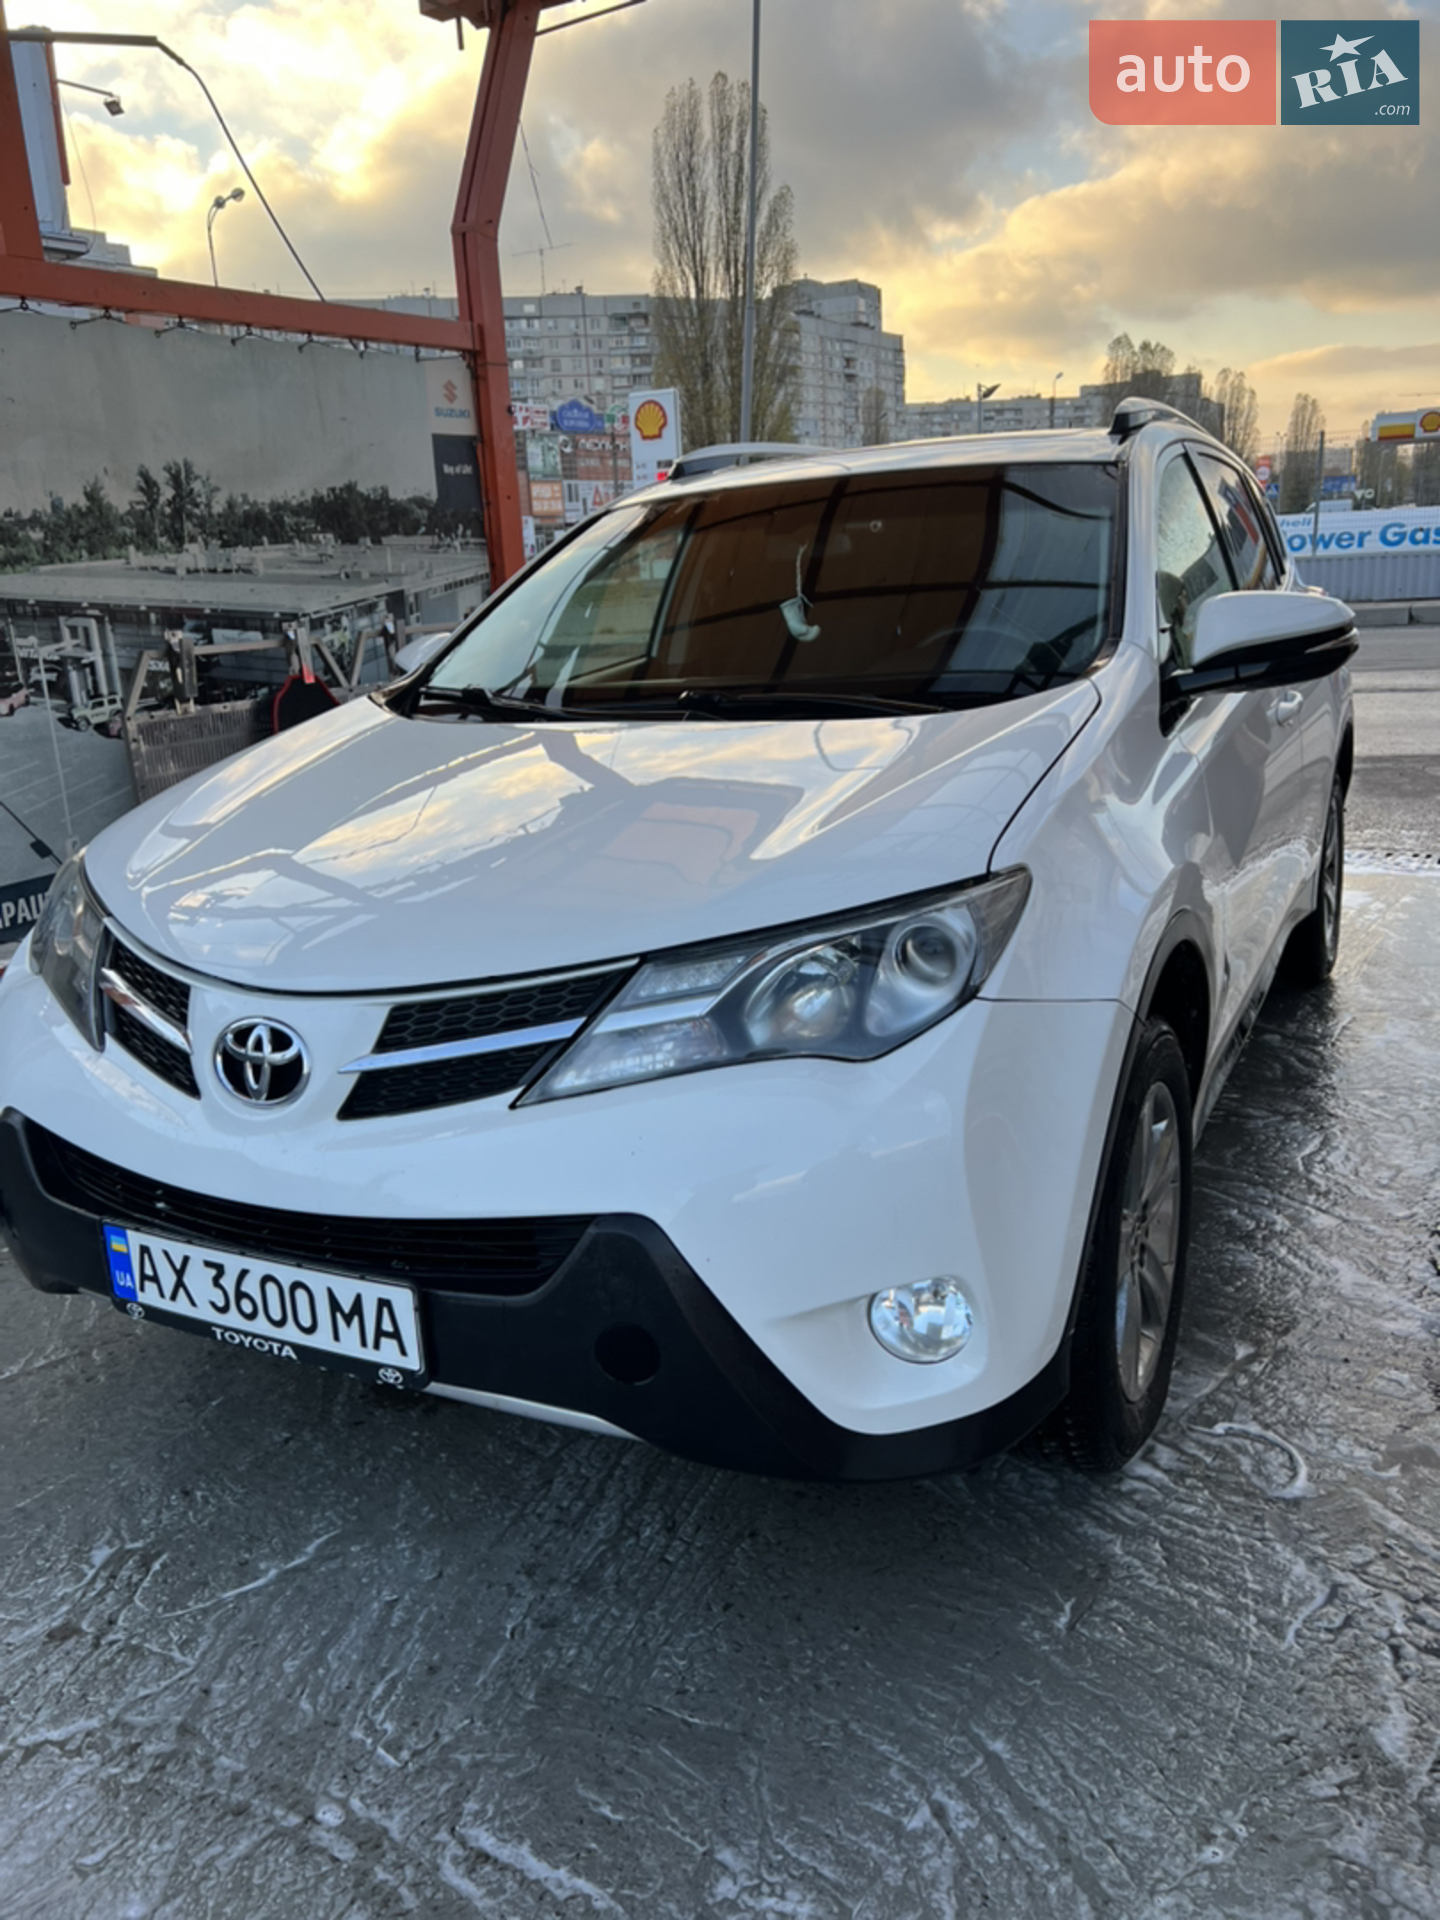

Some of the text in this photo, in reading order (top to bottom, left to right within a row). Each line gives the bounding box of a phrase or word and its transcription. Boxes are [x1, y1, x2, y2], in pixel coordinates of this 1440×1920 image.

[434, 406, 470, 419] SUZUKI
[1280, 517, 1312, 527] hell
[1286, 529, 1372, 552] ower
[115, 1270, 134, 1290] UA
[138, 1243, 409, 1358] AX 3600 MA
[210, 1326, 299, 1361] TOYOTA
